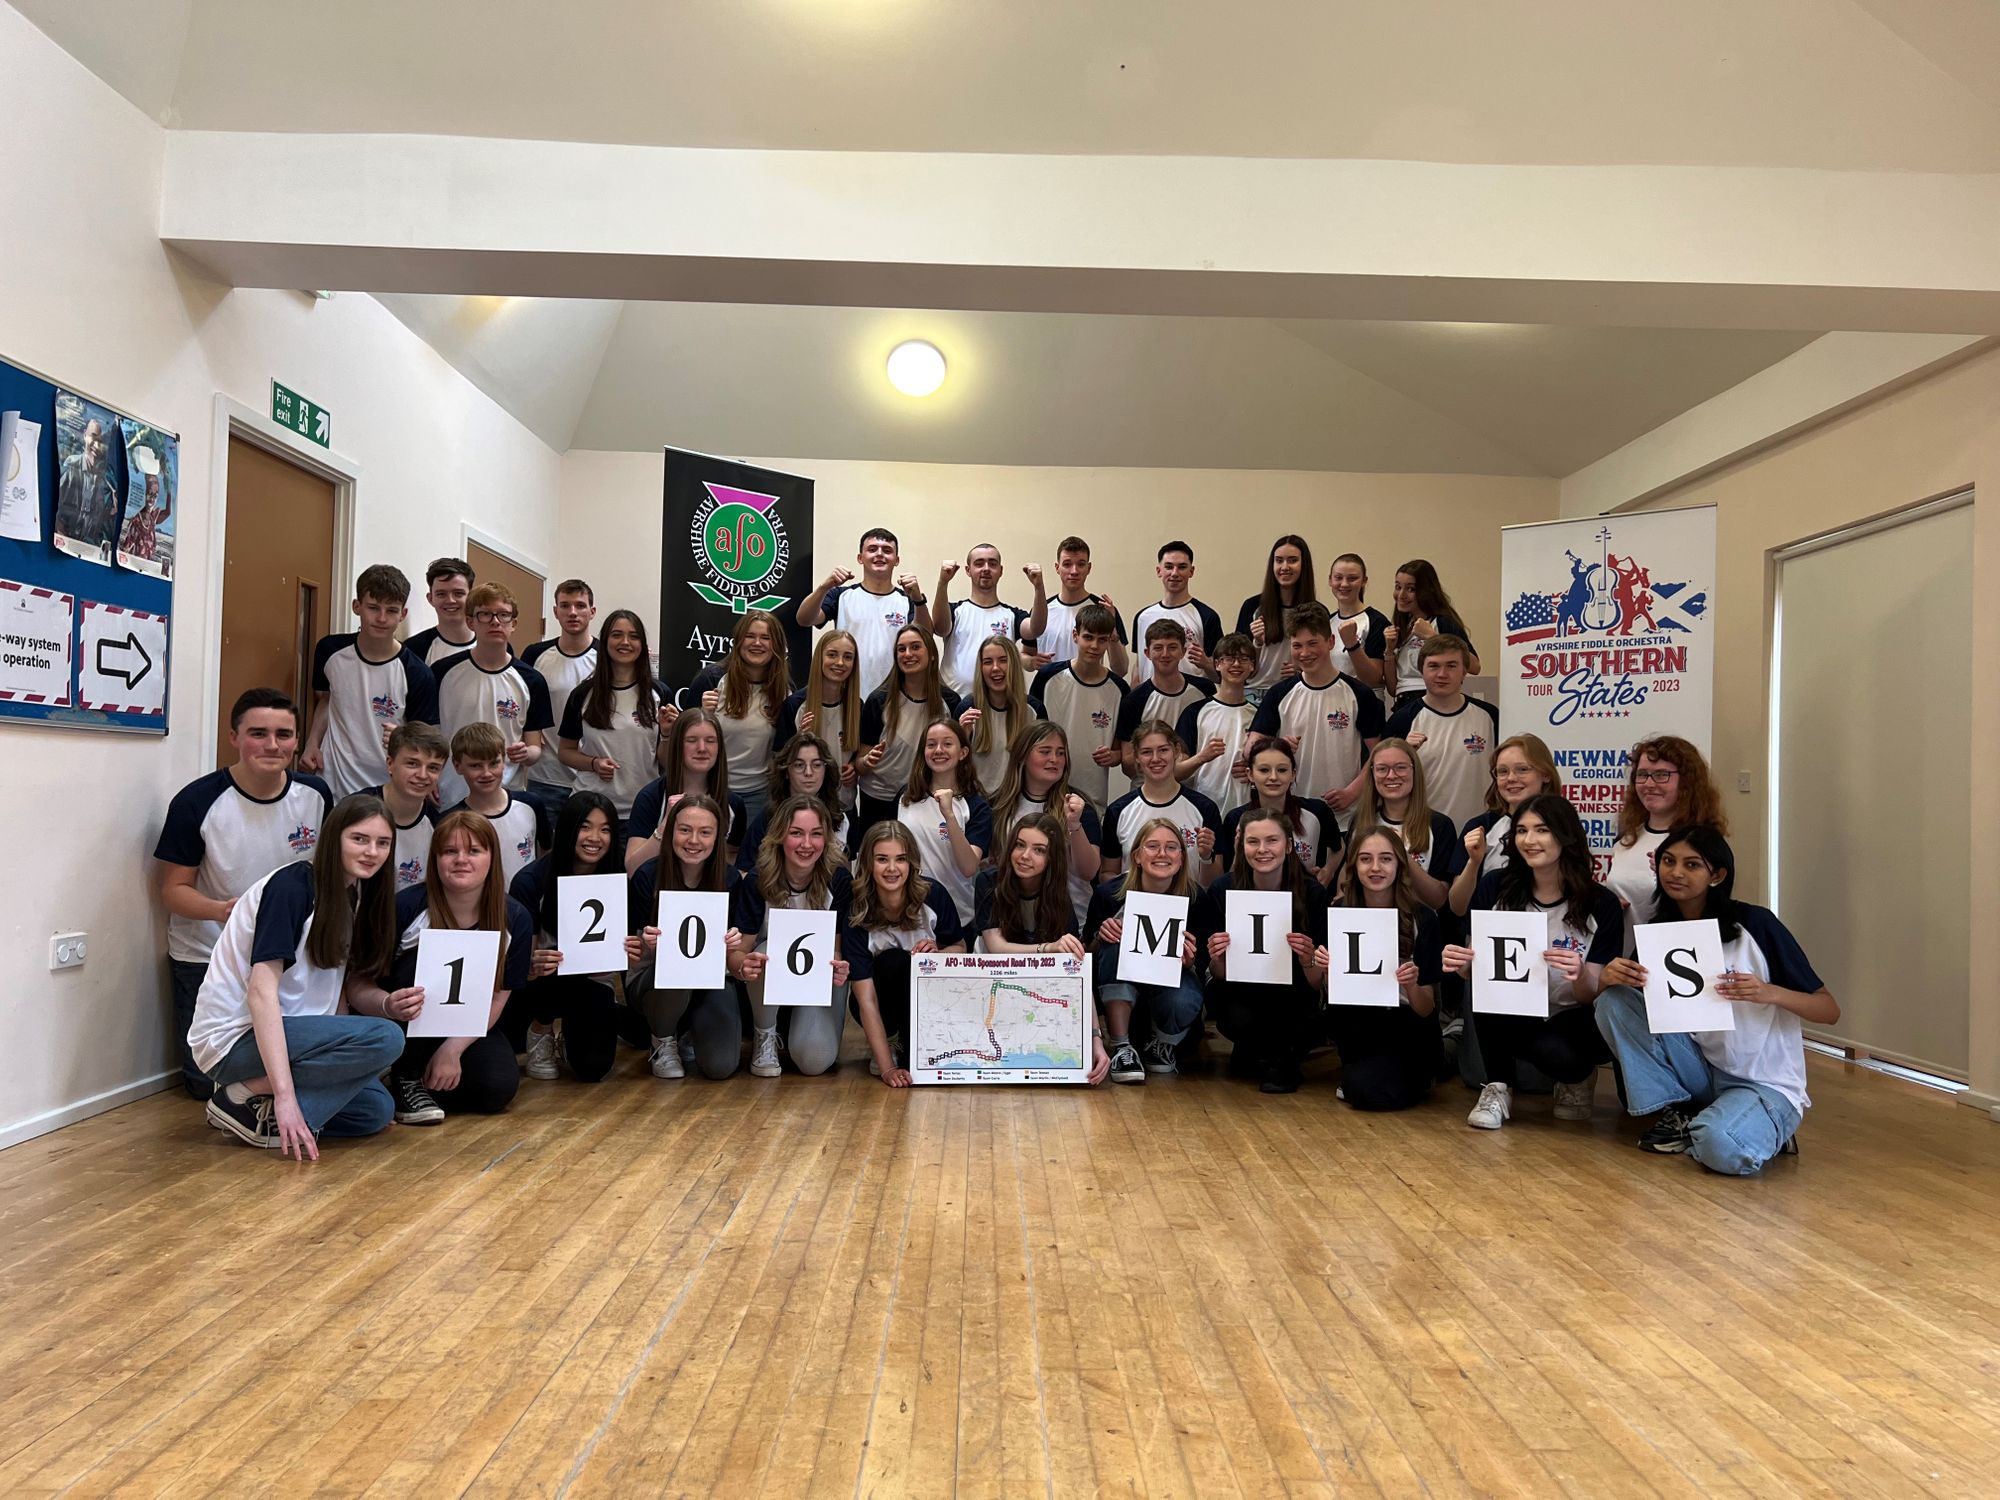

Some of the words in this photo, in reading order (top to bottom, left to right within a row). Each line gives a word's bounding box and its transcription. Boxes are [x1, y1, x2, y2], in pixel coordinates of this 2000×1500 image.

[276, 388, 292, 408] Fire
[276, 408, 291, 425] exit
[690, 495, 715, 570] AYRSHIRE
[704, 567, 759, 598] FIDDLE
[759, 507, 790, 593] ORCHESTRA
[28, 637, 61, 653] system
[1535, 640, 1580, 652] AYRSHIRE
[1581, 638, 1614, 649] FIDDLE
[1616, 635, 1673, 647] ORCHESTRA
[3, 653, 51, 670] operation
[1520, 645, 1687, 680] SOUTHERN
[1527, 684, 1553, 697] TOUR
[1549, 667, 1649, 726] States
[1652, 679, 1680, 693] 2023
[1553, 750, 1630, 767] NEWNA
[1573, 768, 1625, 779] GEORGIA
[1561, 784, 1630, 801] EMPH
[578, 898, 607, 944] 2
[678, 914, 707, 959] 0
[1128, 913, 1185, 958] M
[1247, 913, 1270, 955] I
[786, 932, 816, 976] 6
[945, 957, 958, 967] AFO
[963, 957, 976, 967] USA
[977, 958, 1009, 970] Sponsored
[1010, 957, 1026, 967] Road
[1027, 957, 1039, 969] Trip
[1040, 957, 1056, 967] 2023
[1342, 931, 1383, 975] L
[1487, 935, 1531, 983] E
[439, 957, 466, 1006] 1
[1663, 947, 1705, 999] S
